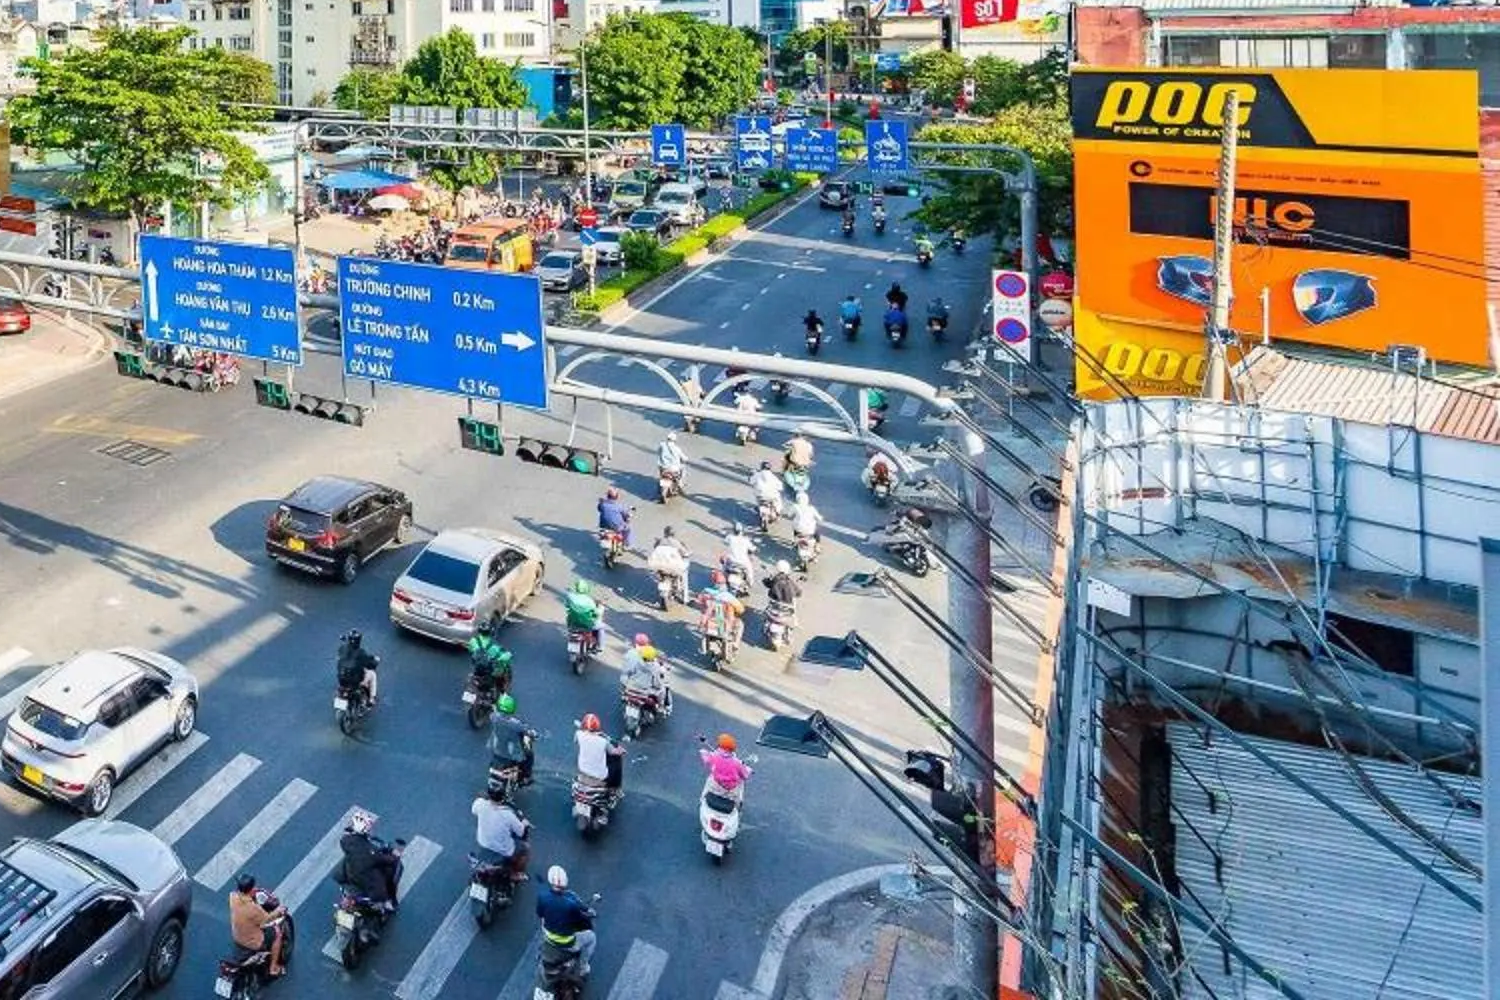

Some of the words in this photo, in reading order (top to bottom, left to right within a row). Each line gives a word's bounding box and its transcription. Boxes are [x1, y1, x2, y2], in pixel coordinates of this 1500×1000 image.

[1113, 125, 1160, 136] POWER
[1163, 126, 1181, 136] OF
[393, 283, 431, 303] CHINH
[473, 293, 495, 312] Km
[476, 336, 498, 355] Km
